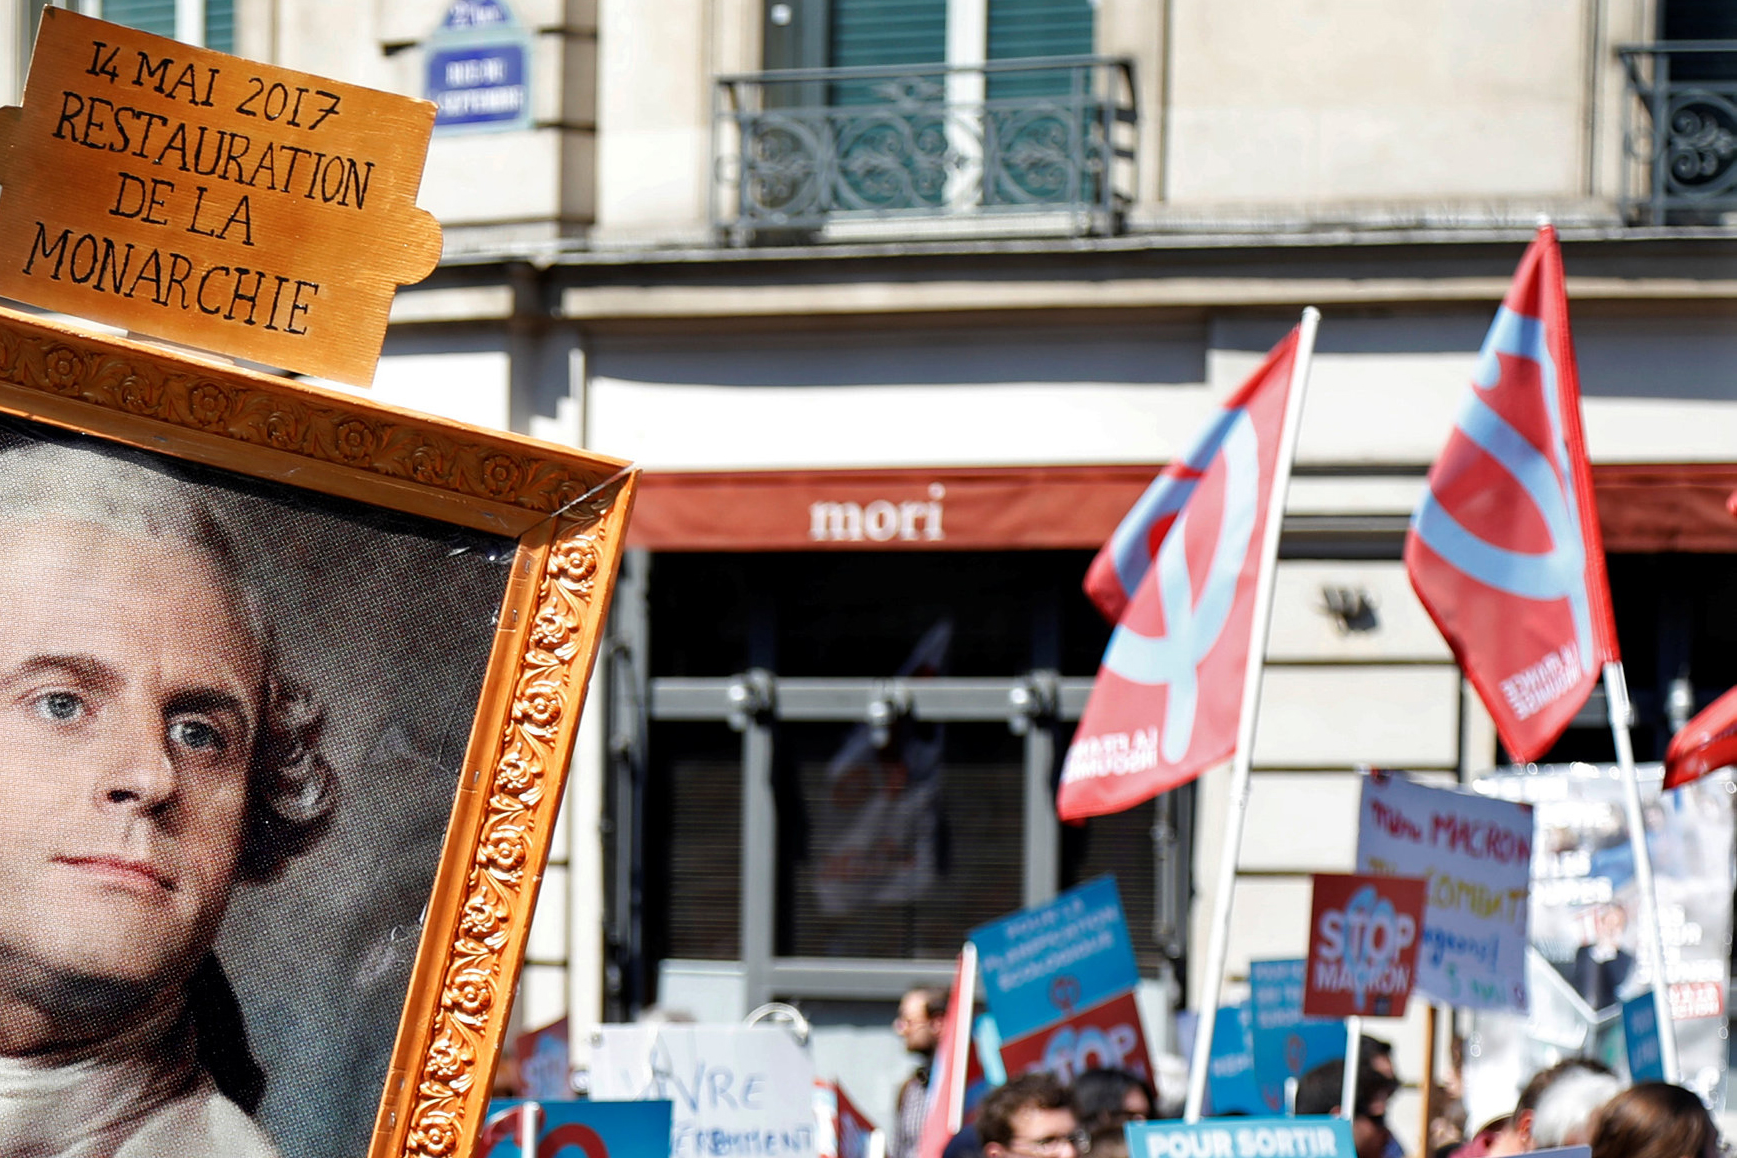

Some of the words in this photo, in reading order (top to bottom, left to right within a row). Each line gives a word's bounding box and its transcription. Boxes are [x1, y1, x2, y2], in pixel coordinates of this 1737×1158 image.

[132, 51, 220, 107] MAI
[236, 77, 341, 130] 2017
[52, 91, 375, 209] RESTAURATION
[109, 172, 174, 225] DE
[187, 187, 256, 246] LA
[22, 222, 319, 335] MONARCHIE
[808, 482, 946, 541] mori
[1317, 901, 1416, 965] STOP
[1237, 1127, 1337, 1158] SORTIR
